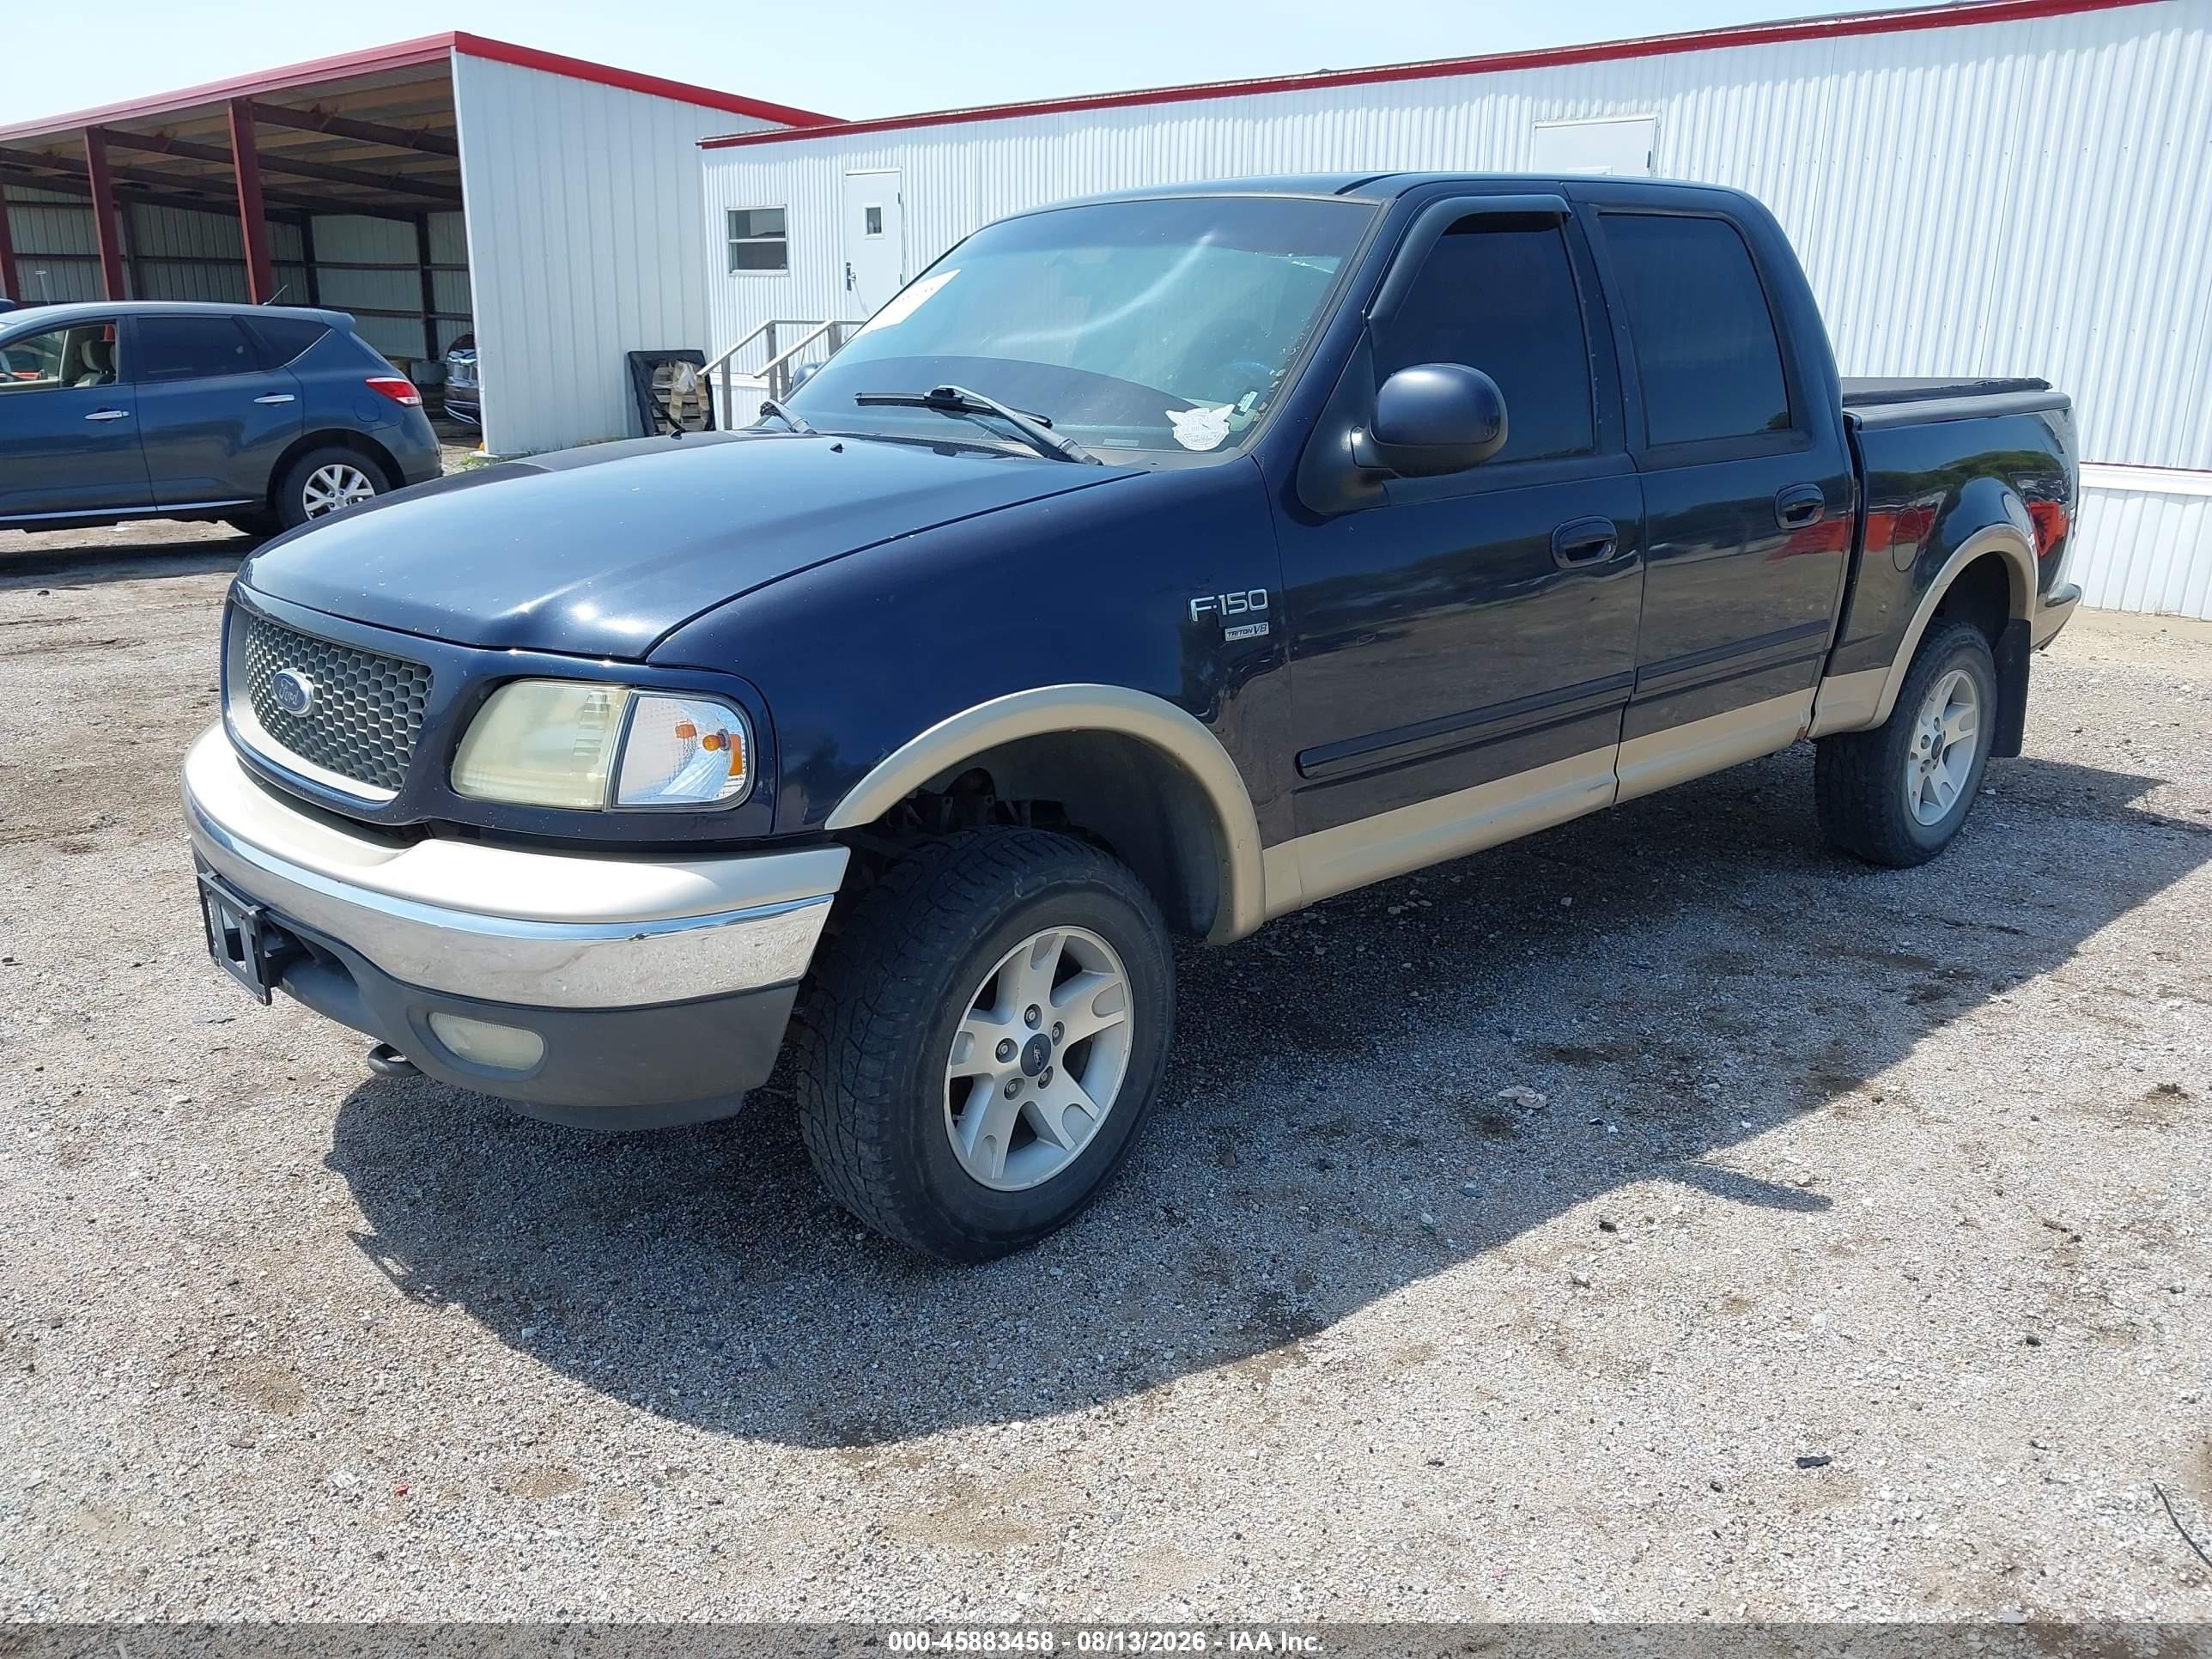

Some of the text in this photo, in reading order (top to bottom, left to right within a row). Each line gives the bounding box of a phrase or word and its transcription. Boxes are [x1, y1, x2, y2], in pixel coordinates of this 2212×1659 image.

[1189, 588, 1269, 622] F-150
[1226, 623, 1267, 638] TRITON V8
[278, 678, 299, 707] Ford
